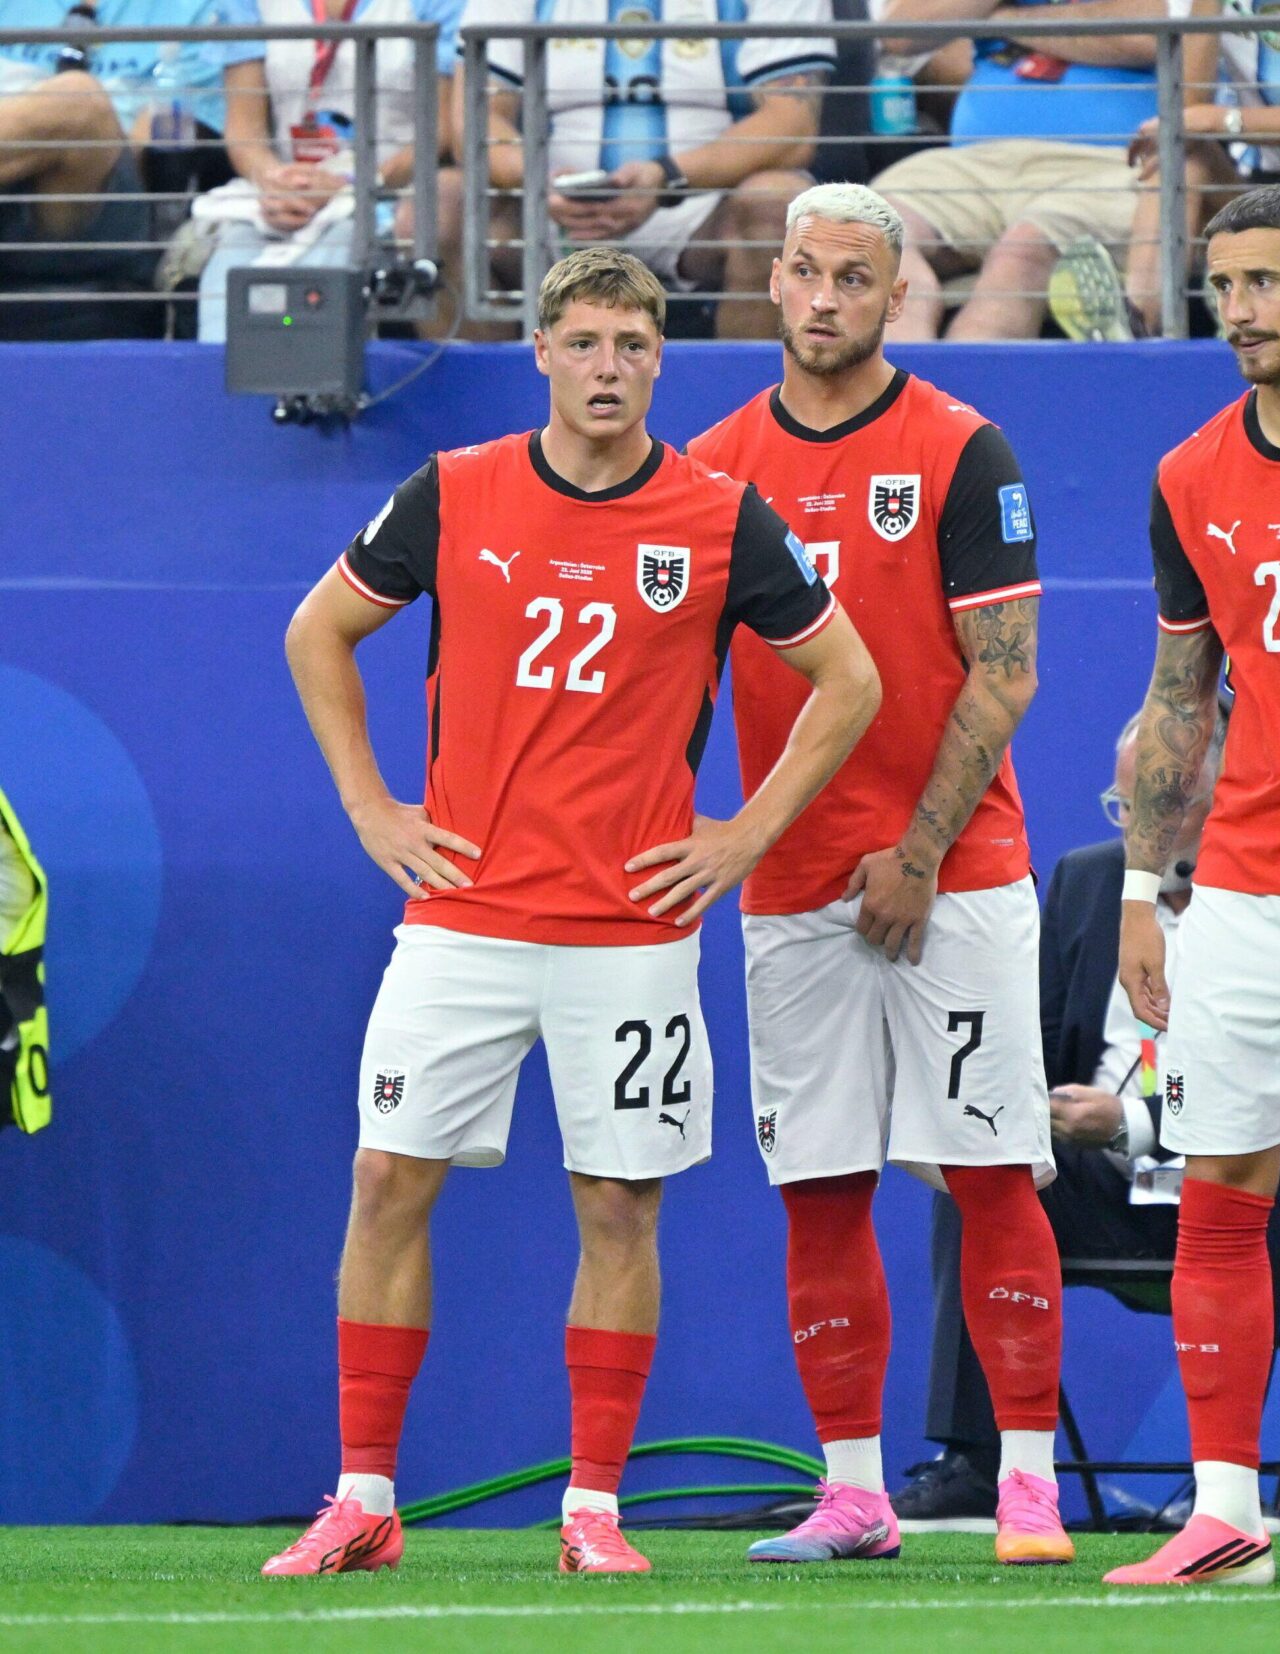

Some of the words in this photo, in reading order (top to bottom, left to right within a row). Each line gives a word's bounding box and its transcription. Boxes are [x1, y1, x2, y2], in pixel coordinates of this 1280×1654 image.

[653, 549, 675, 558] ÖFB
[516, 596, 617, 694] 22
[613, 1013, 691, 1110] 22
[947, 1011, 986, 1099] 7
[989, 1287, 1049, 1310] ÖFB
[794, 1317, 850, 1343] ÖFB
